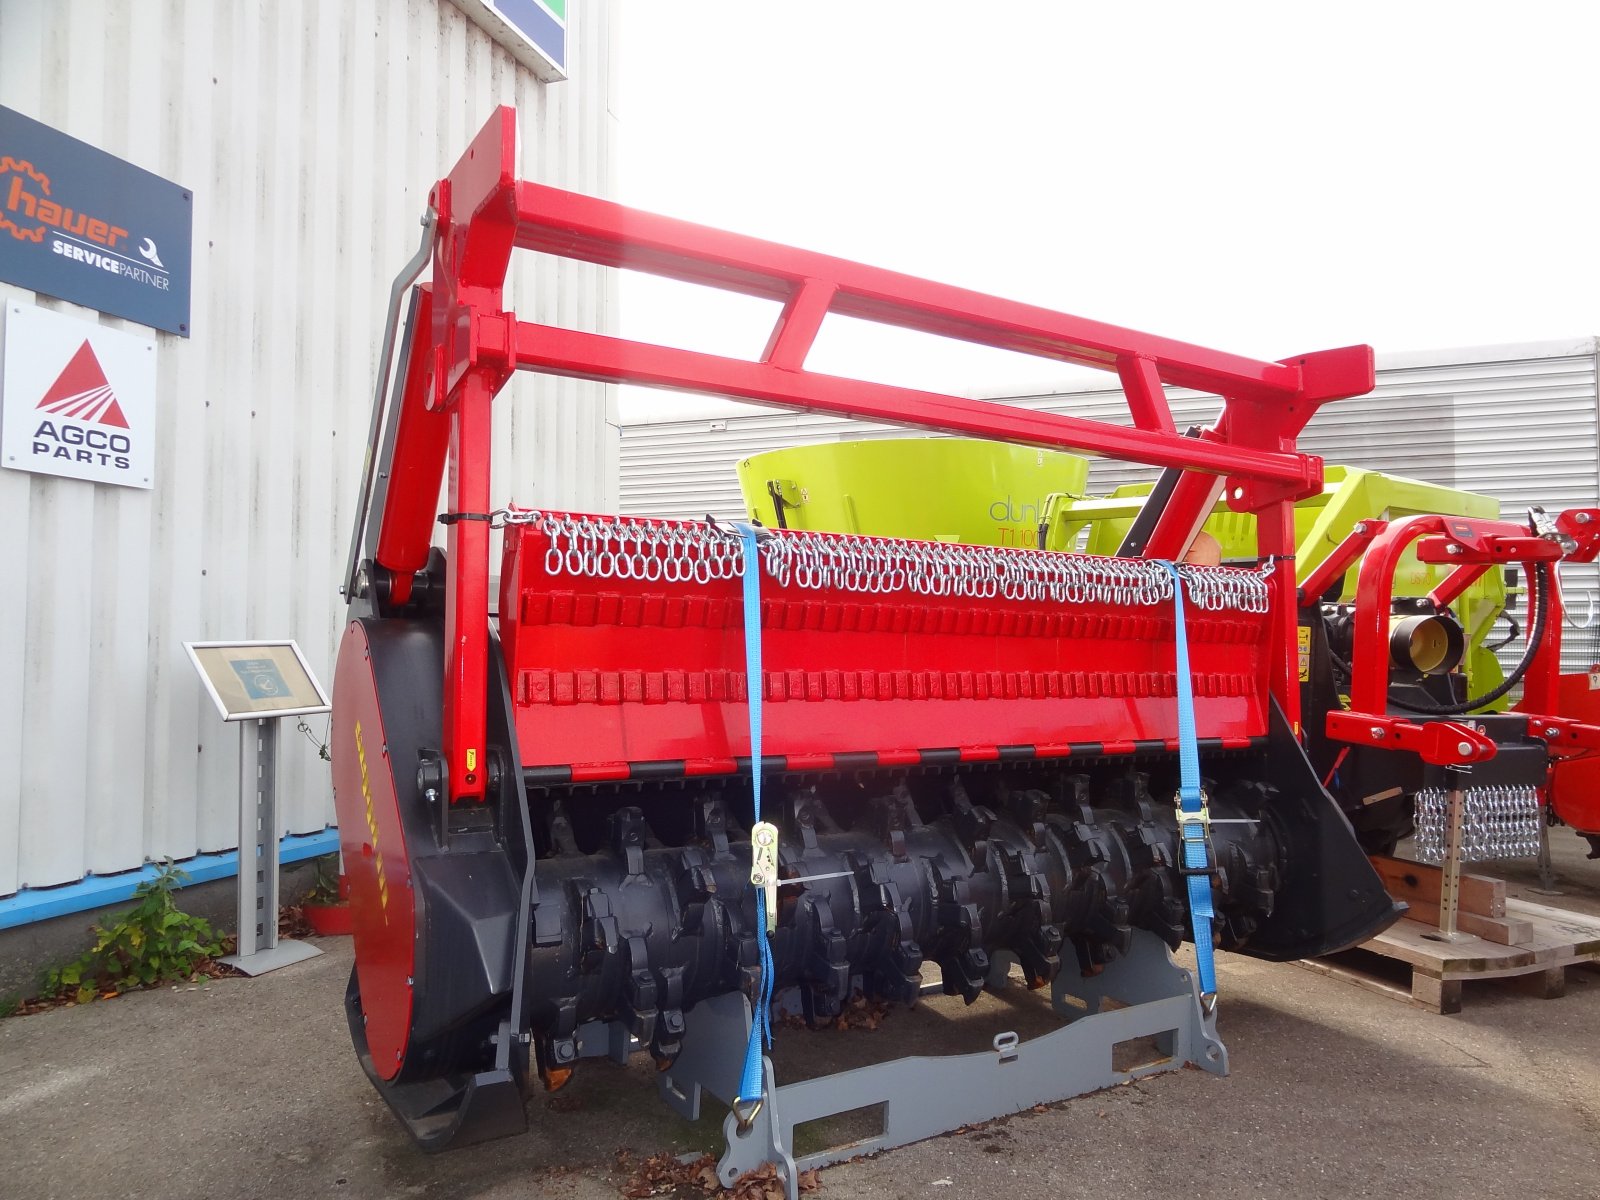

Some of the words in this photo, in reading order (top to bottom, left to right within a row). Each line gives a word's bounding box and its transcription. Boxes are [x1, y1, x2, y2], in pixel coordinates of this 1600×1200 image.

[7, 176, 128, 247] hauer
[34, 420, 131, 453] AGCO
[32, 441, 130, 470] PARTS
